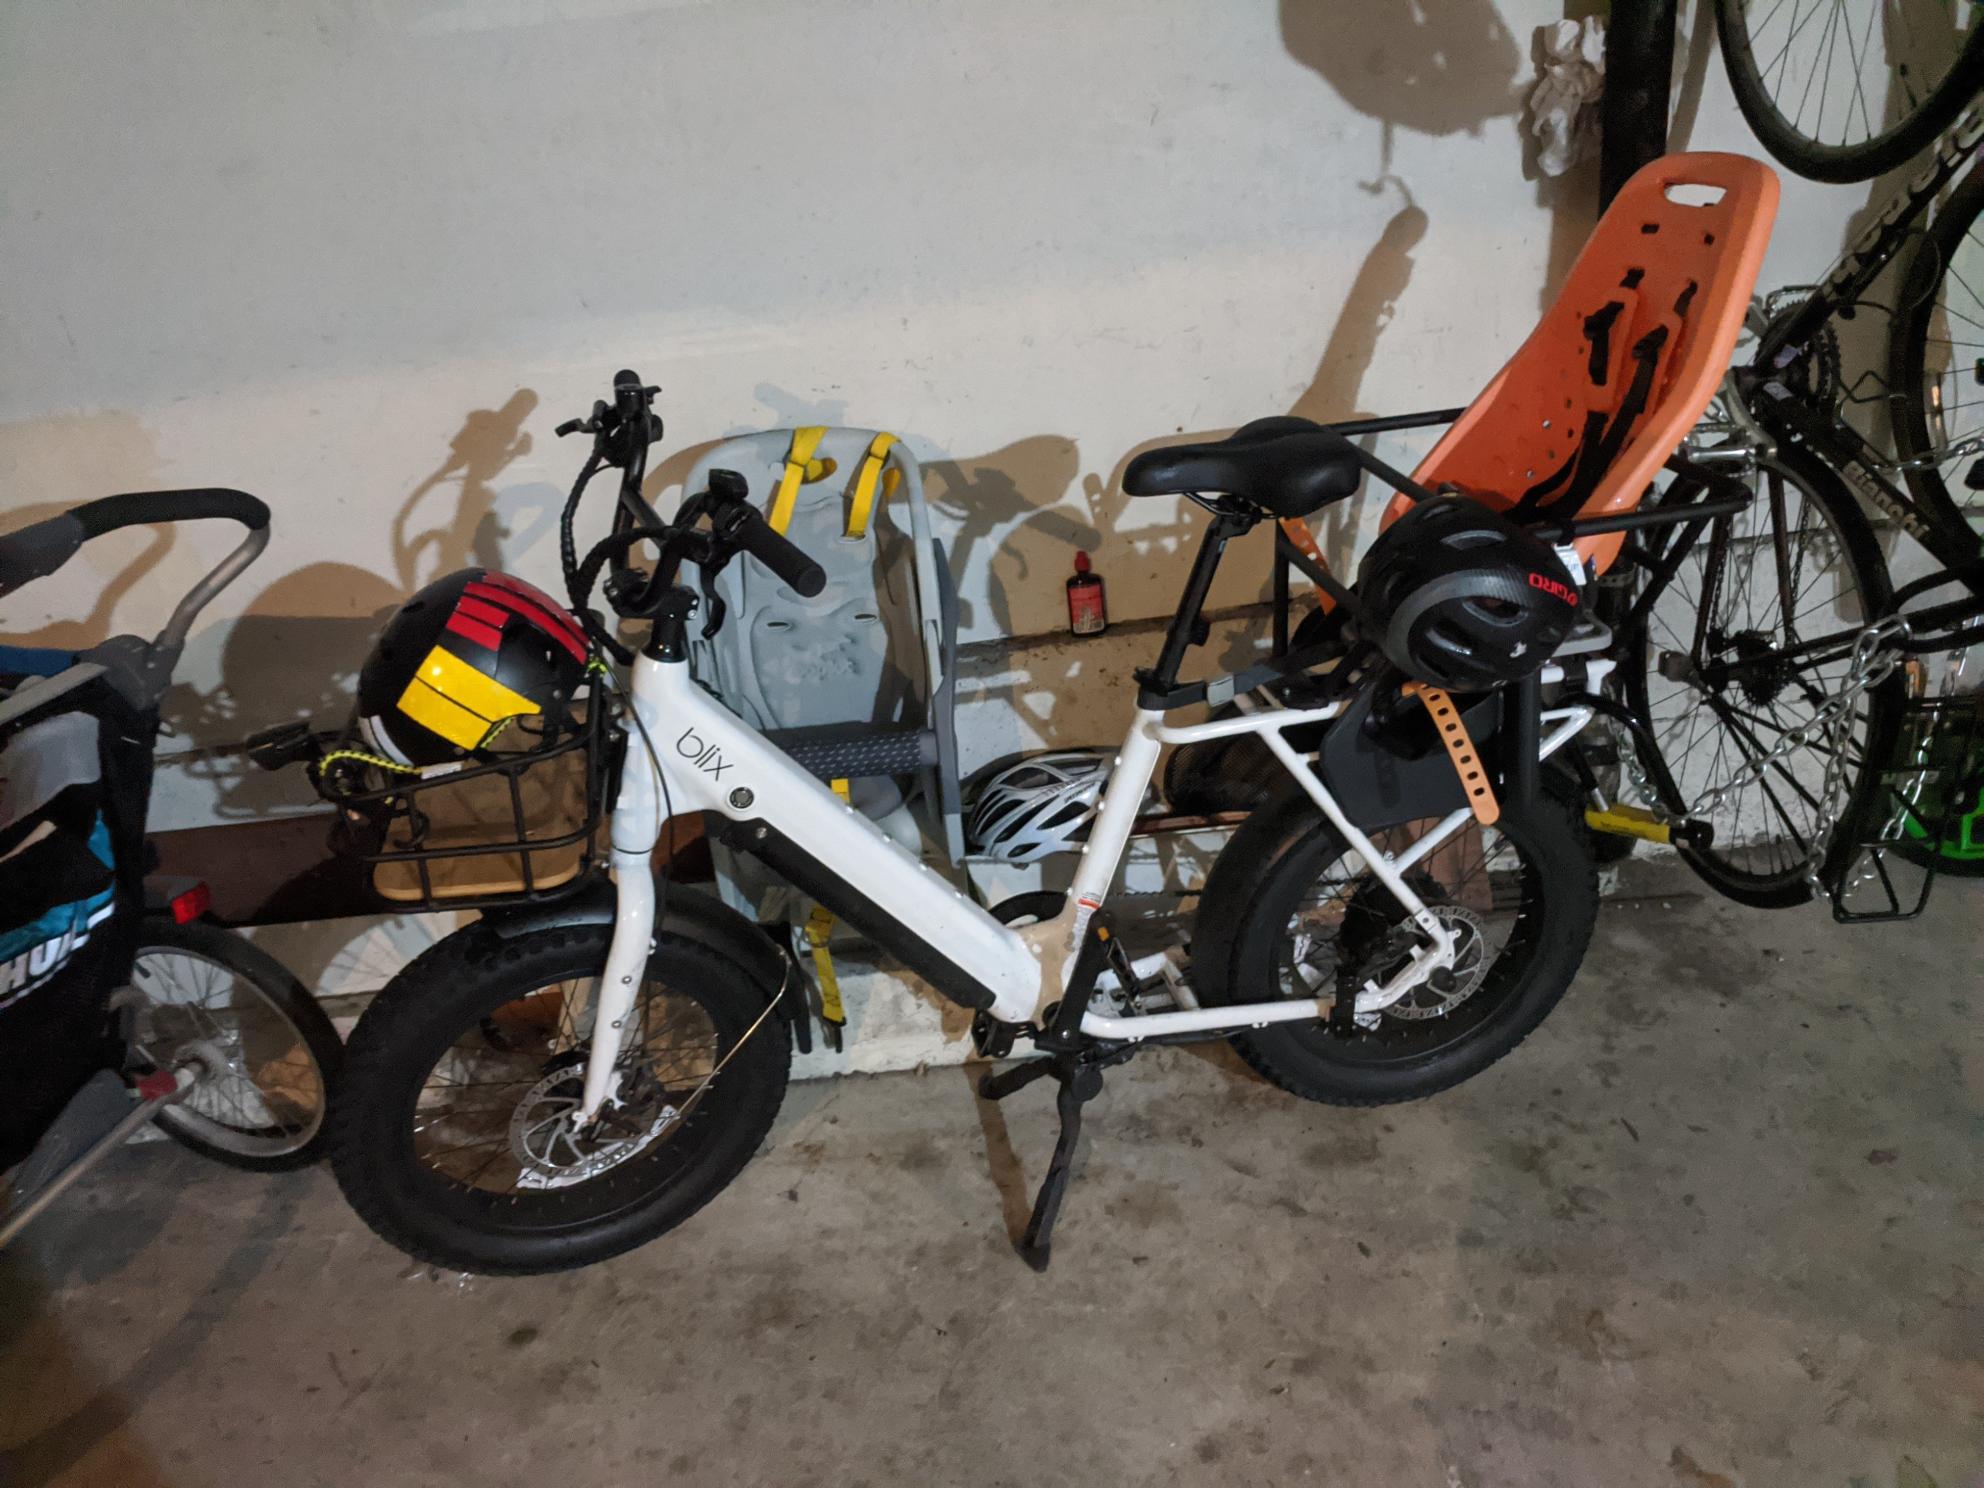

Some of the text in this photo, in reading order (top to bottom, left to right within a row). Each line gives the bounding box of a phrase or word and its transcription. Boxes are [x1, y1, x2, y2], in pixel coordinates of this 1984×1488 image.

[1842, 460, 1930, 539] Bianchi
[1528, 572, 1568, 601] GIRO
[676, 726, 735, 782] blix
